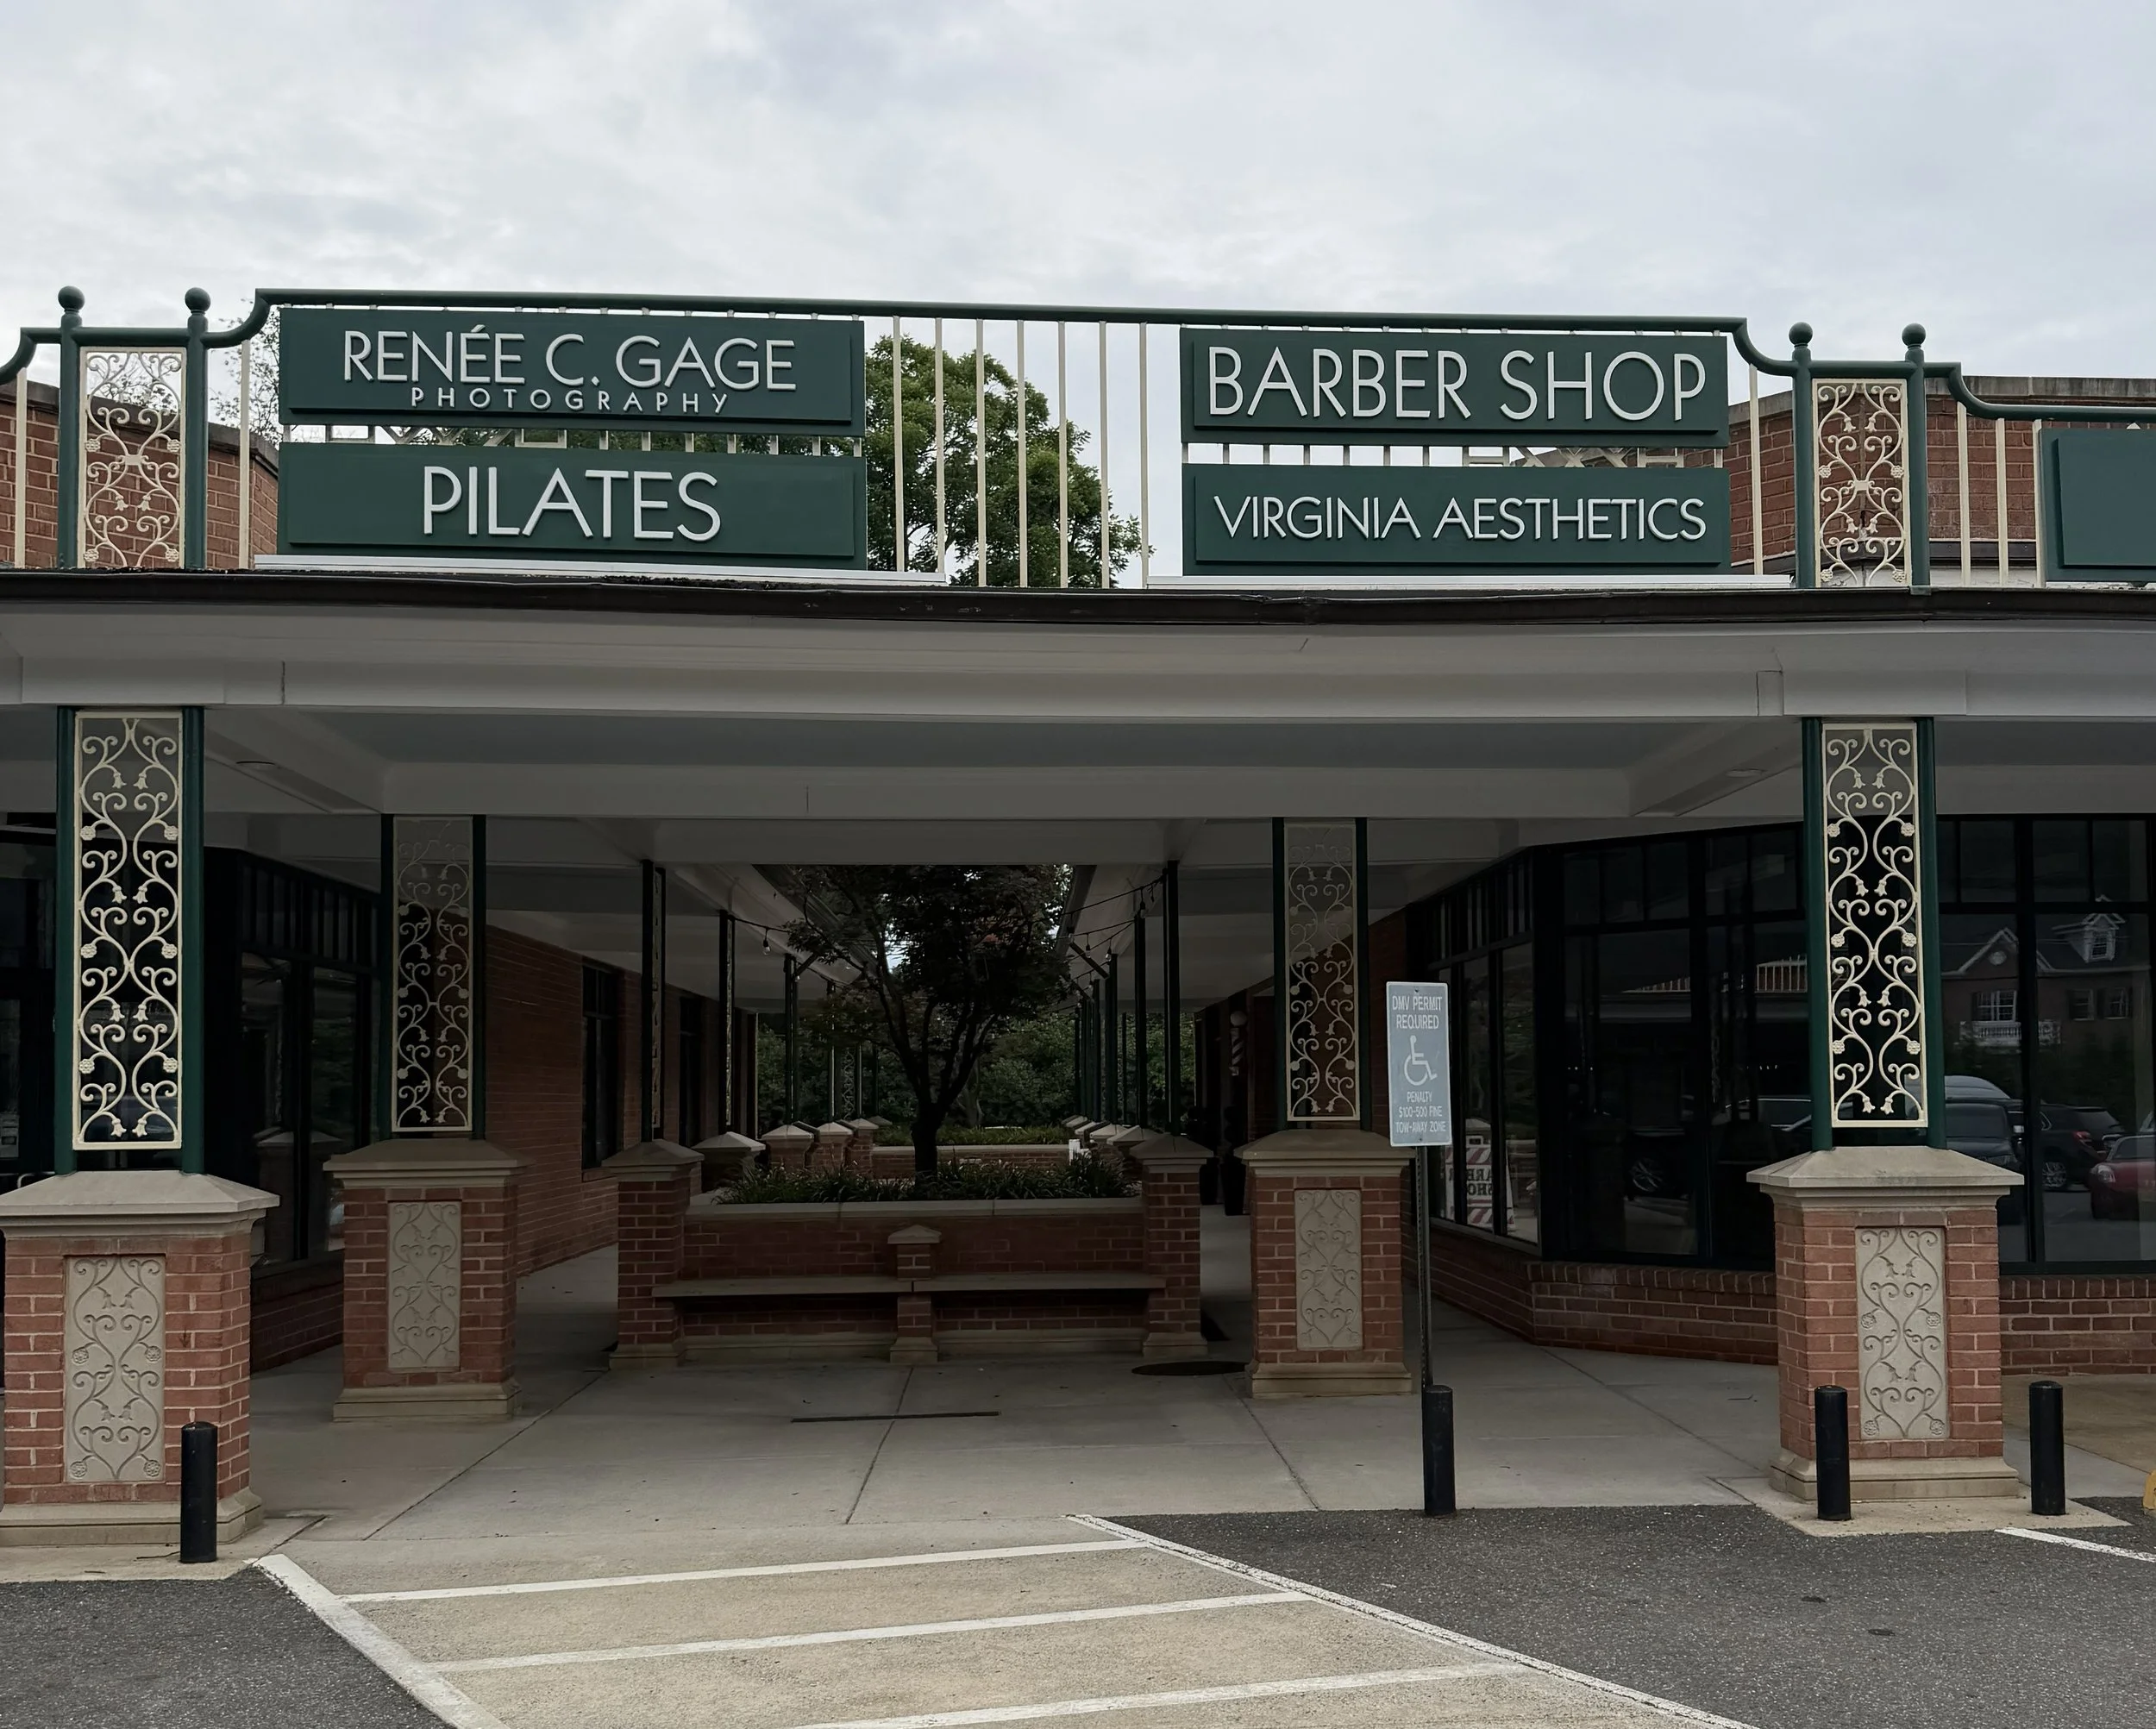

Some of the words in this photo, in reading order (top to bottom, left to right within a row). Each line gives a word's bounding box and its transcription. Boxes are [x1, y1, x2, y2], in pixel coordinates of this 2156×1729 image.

[344, 324, 525, 385] RENÉE
[545, 333, 599, 386] C.
[615, 335, 797, 392] GAGE
[1208, 346, 1471, 419] BARBER
[1500, 349, 1706, 422] SHOP
[411, 386, 728, 415] PHOTOGRAPHY
[423, 466, 722, 542] PILATES
[1213, 495, 1421, 540] VIRGINIA
[1432, 496, 1707, 541] AESTHETICS
[1392, 995, 1409, 1010] DMV
[1413, 996, 1443, 1011] PERMIT
[1396, 1014, 1439, 1029] REQUIRED
[1407, 1091, 1432, 1103] PENALTY
[1429, 1106, 1443, 1117] FINE
[1395, 1120, 1428, 1133] TOW-AWAY
[1429, 1120, 1446, 1132] ZONE
